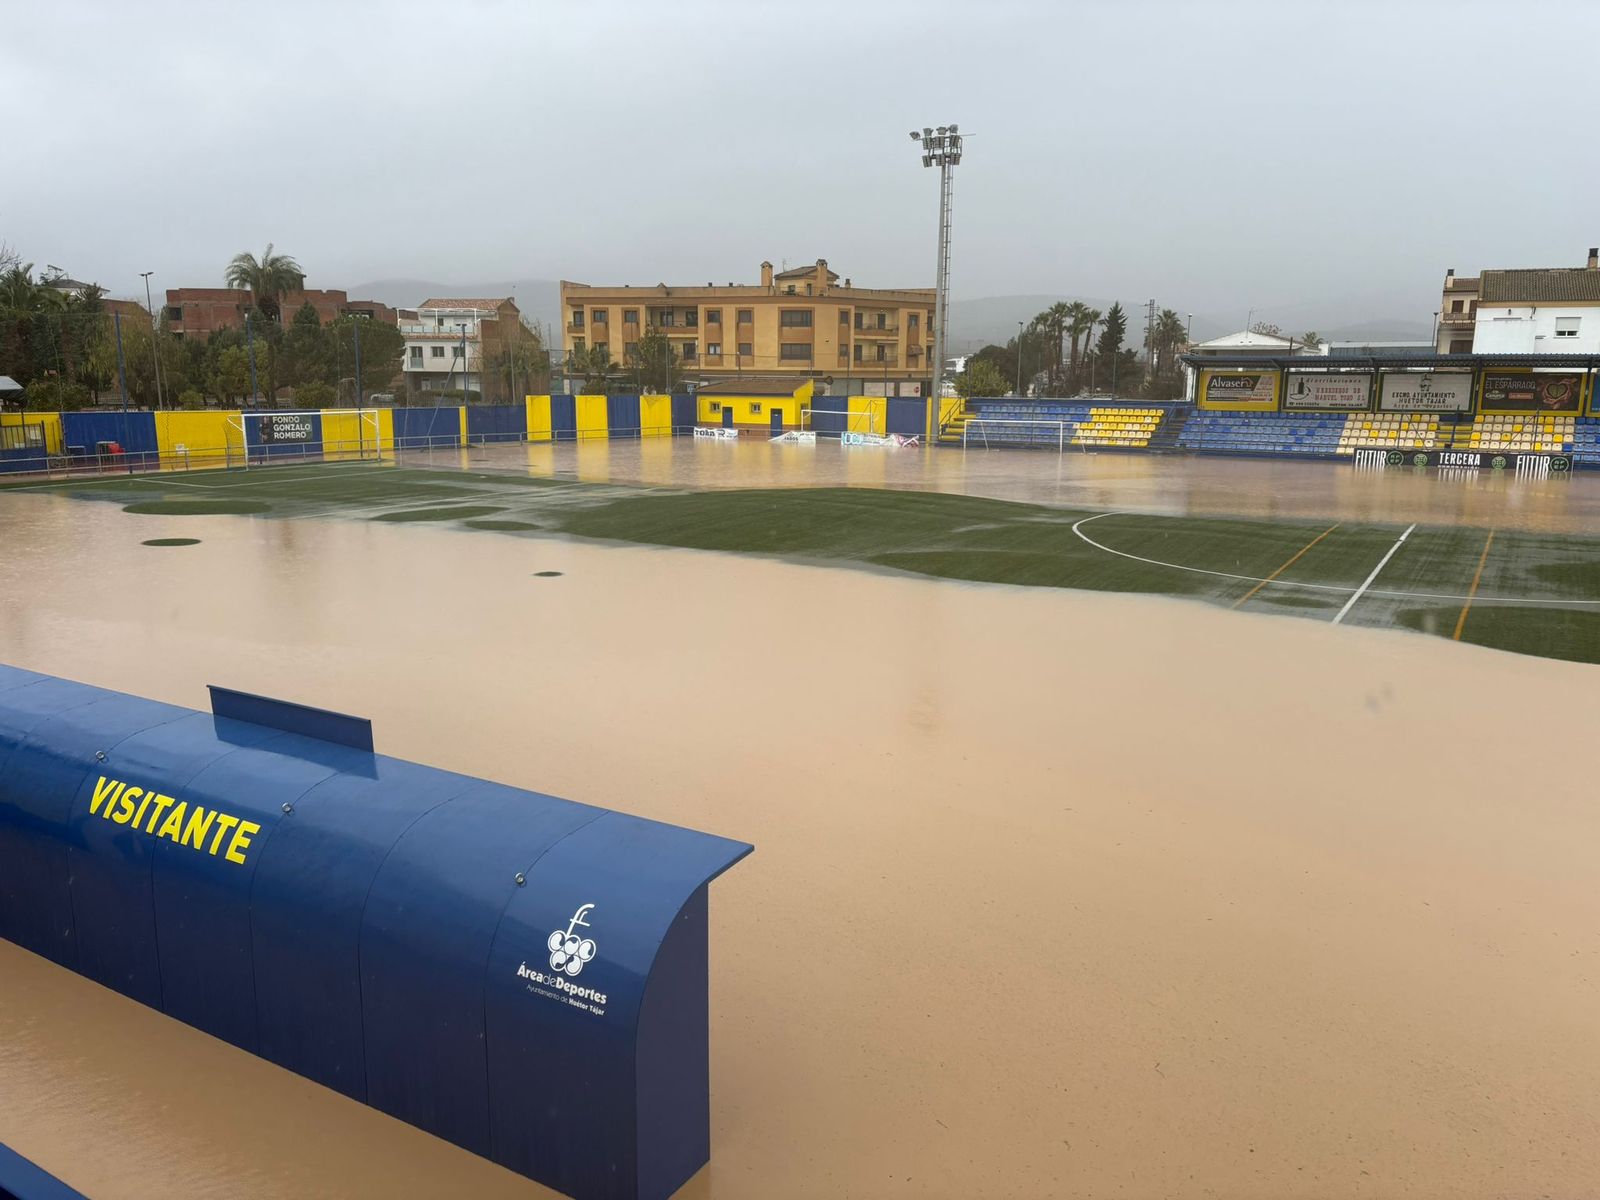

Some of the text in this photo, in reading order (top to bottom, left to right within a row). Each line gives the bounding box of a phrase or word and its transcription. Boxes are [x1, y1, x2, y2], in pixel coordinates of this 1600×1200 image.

[1211, 377, 1244, 388] Alvaser
[273, 423, 311, 431] GONZALO
[274, 431, 307, 439] ROMERO
[1439, 452, 1481, 466] TERCERA
[89, 775, 261, 865] VISITANTE
